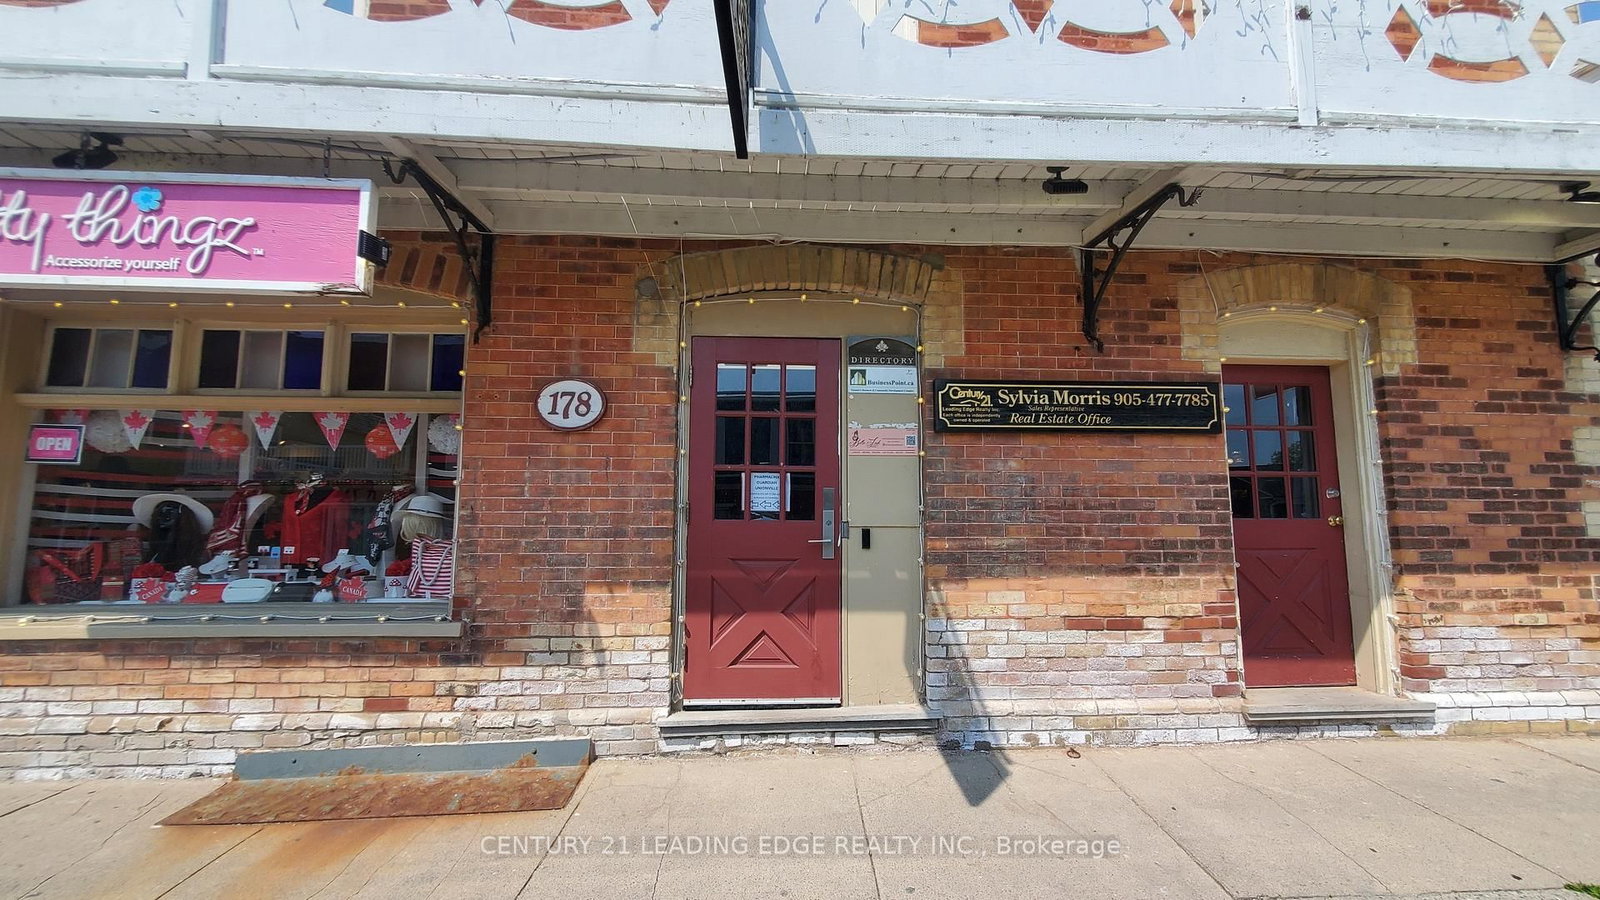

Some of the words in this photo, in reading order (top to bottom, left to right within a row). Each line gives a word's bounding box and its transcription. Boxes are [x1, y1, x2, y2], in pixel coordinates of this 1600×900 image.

[61, 185, 256, 274] thingz
[44, 255, 122, 268] Accessorize
[124, 258, 180, 271] yourself
[851, 356, 914, 364] DIRECTORY
[949, 386, 984, 400] Century
[997, 389, 1049, 407] Sylvia
[1053, 389, 1111, 405] Morris
[1113, 392, 1210, 407] 905-477-7785
[547, 391, 592, 420] 178
[1009, 412, 1035, 424] Real
[1038, 413, 1075, 424] Estate
[1077, 413, 1112, 426] Office
[36, 436, 72, 451] OPEN
